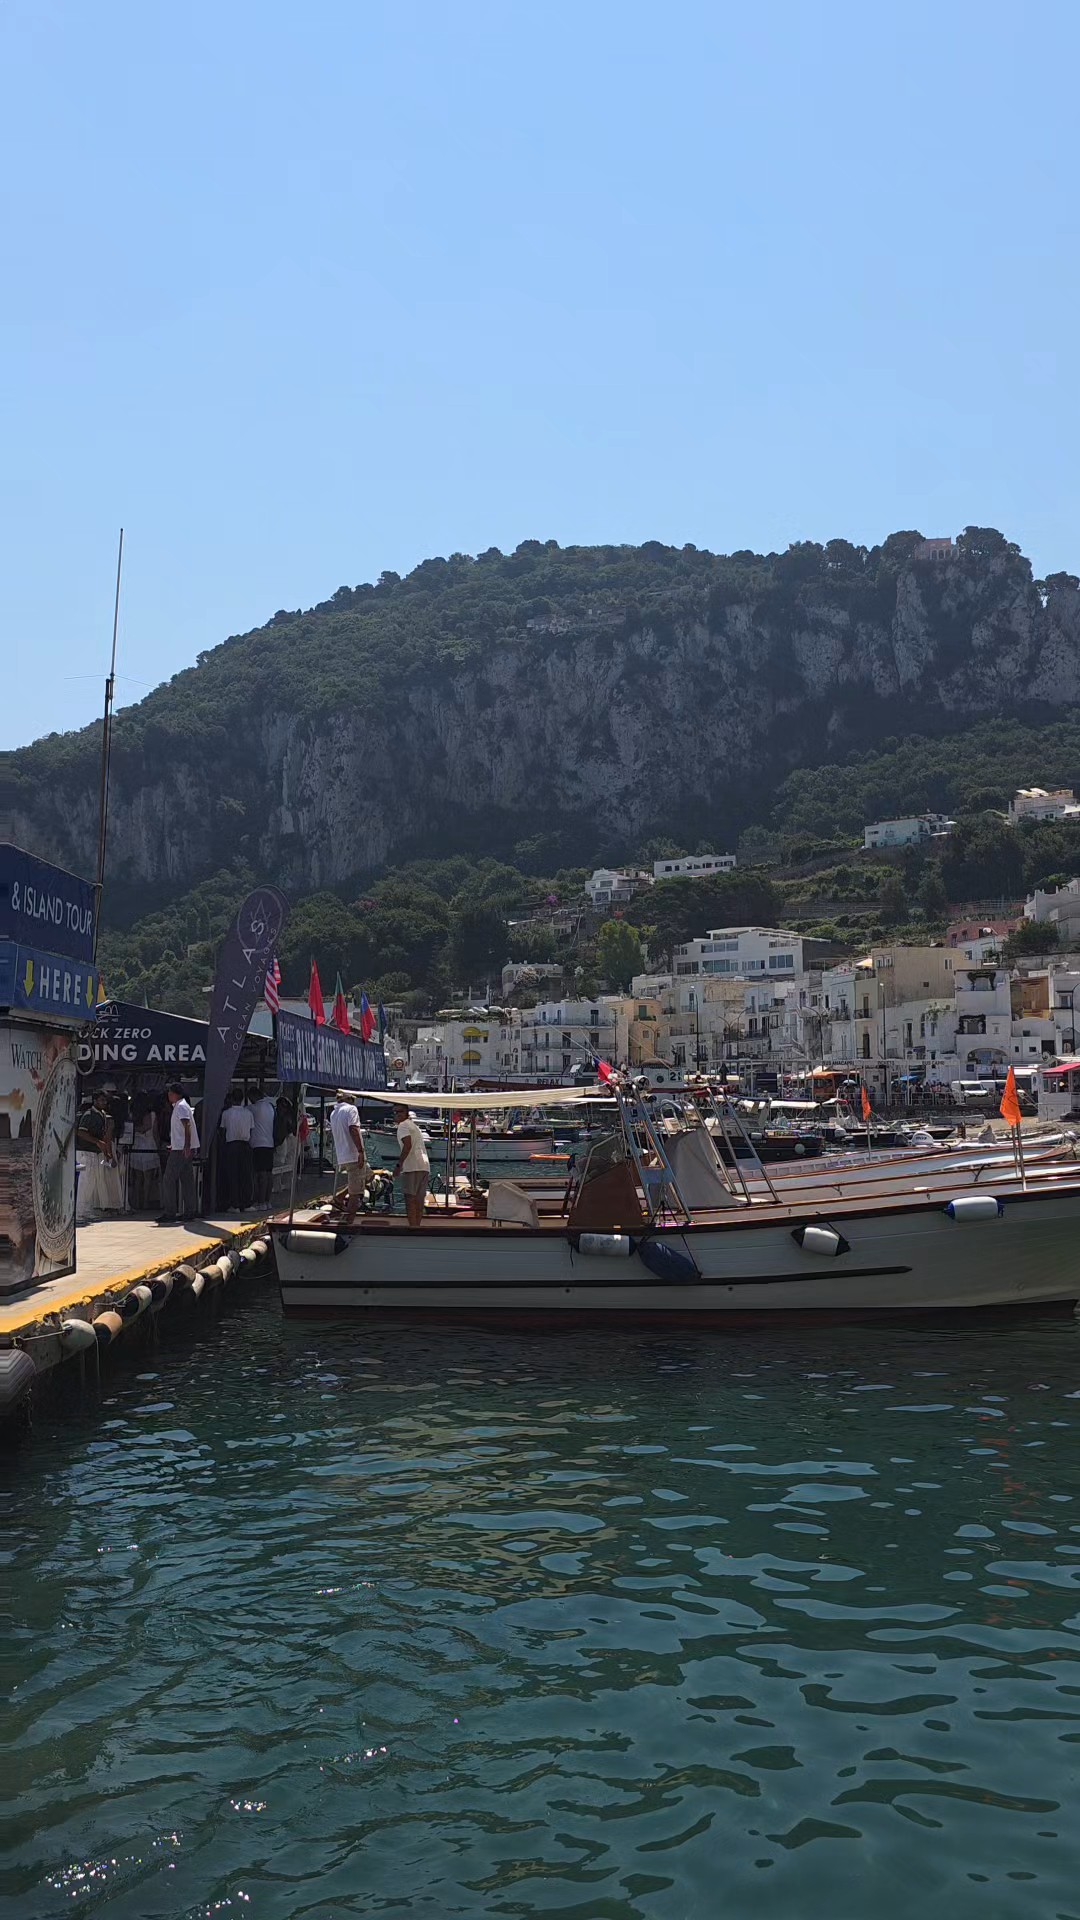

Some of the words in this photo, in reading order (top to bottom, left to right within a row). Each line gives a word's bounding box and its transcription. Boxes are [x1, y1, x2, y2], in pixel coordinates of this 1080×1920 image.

[11, 881, 20, 911] &
[24, 885, 63, 925] ISLAND
[66, 902, 92, 936] TOUR
[39, 965, 82, 1005] HERE
[217, 919, 265, 1043] ATLAS
[232, 1002, 252, 1051] OCEAN
[251, 927, 278, 993] VOYAGES
[78, 1044, 137, 1061] DING
[146, 1044, 207, 1061] AREA
[114, 1028, 152, 1039] ZERO
[296, 1028, 316, 1072] BLUE
[537, 1078, 560, 1086] RELAX
